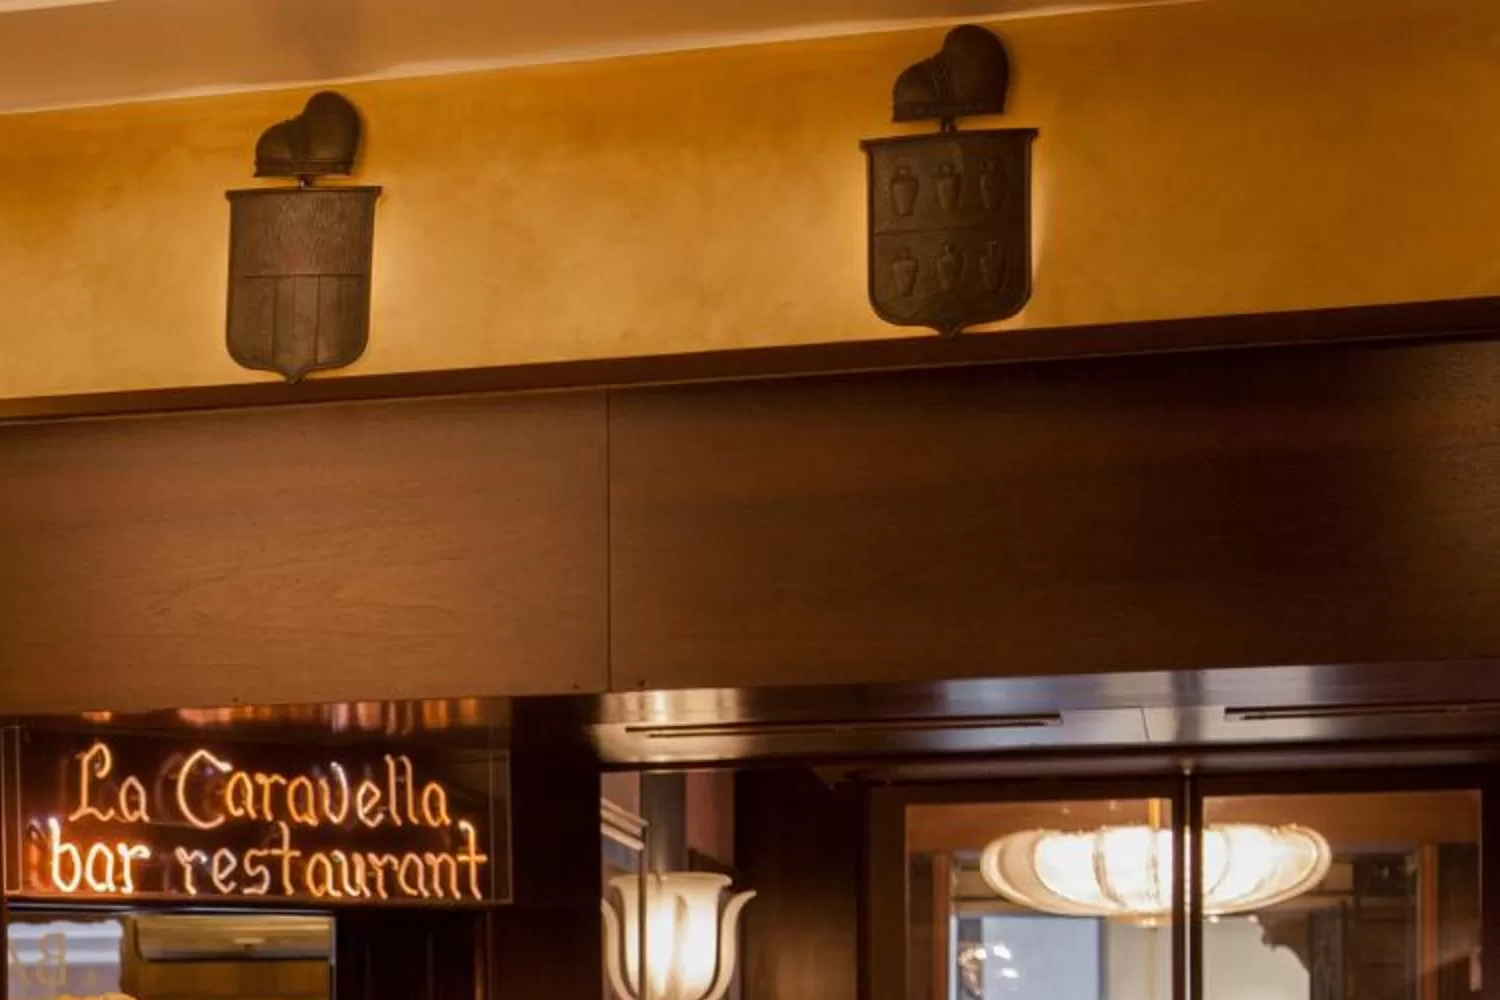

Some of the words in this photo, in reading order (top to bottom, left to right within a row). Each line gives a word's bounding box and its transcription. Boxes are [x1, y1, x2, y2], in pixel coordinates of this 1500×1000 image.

[69, 743, 150, 823] La
[177, 749, 451, 829] Caravella
[49, 818, 150, 894] bar
[175, 821, 488, 900] restaurant
